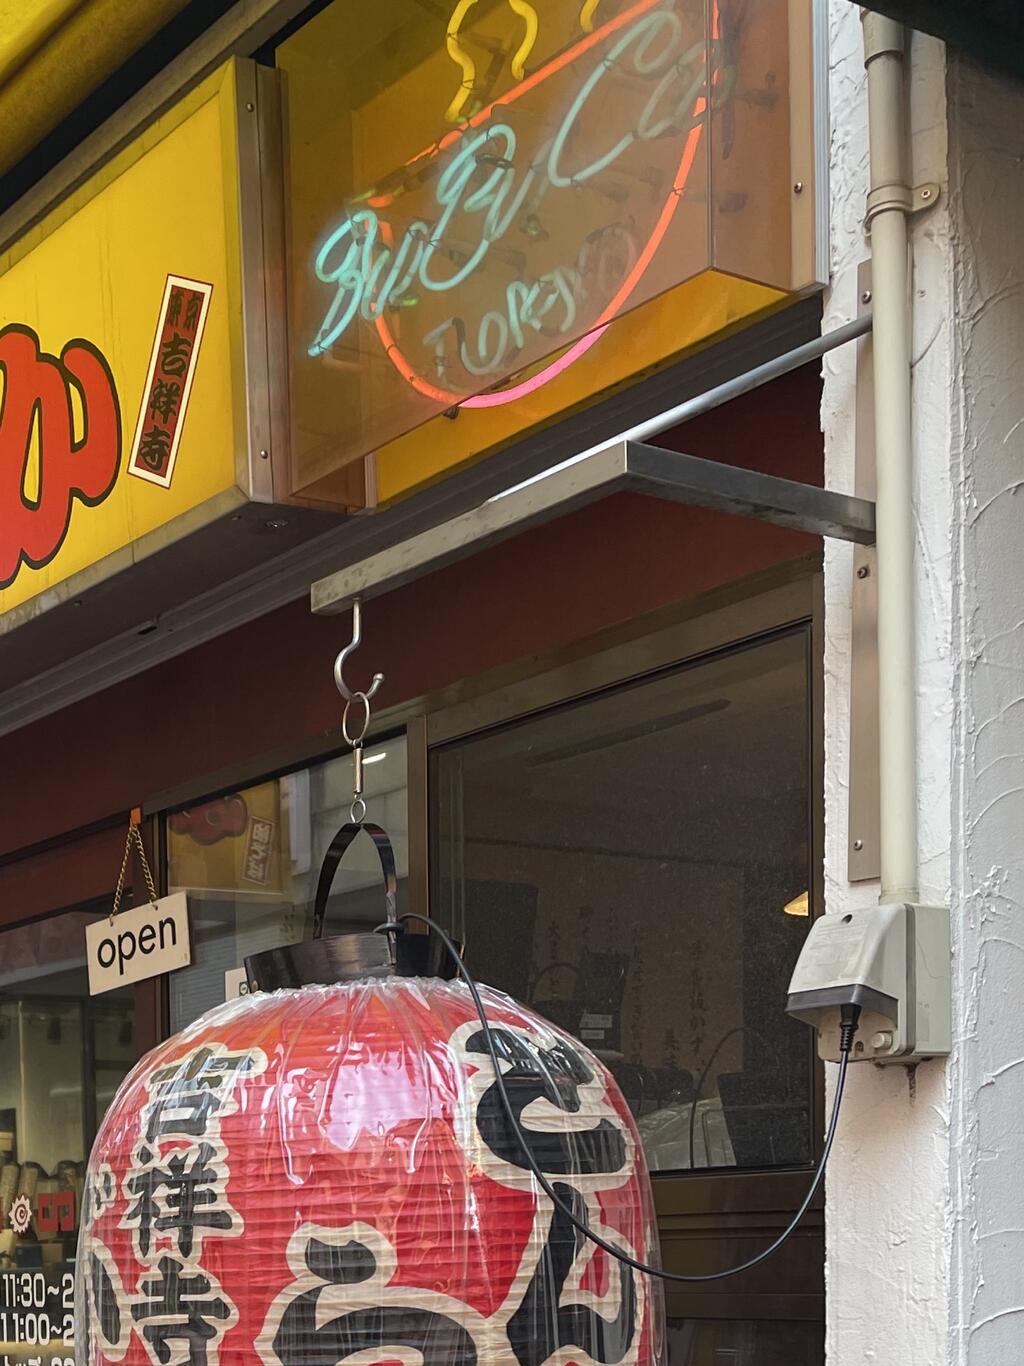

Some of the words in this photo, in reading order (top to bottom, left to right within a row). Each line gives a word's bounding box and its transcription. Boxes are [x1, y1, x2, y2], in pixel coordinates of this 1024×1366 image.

[138, 332, 191, 471] 吉祥寺
[96, 915, 177, 975] open
